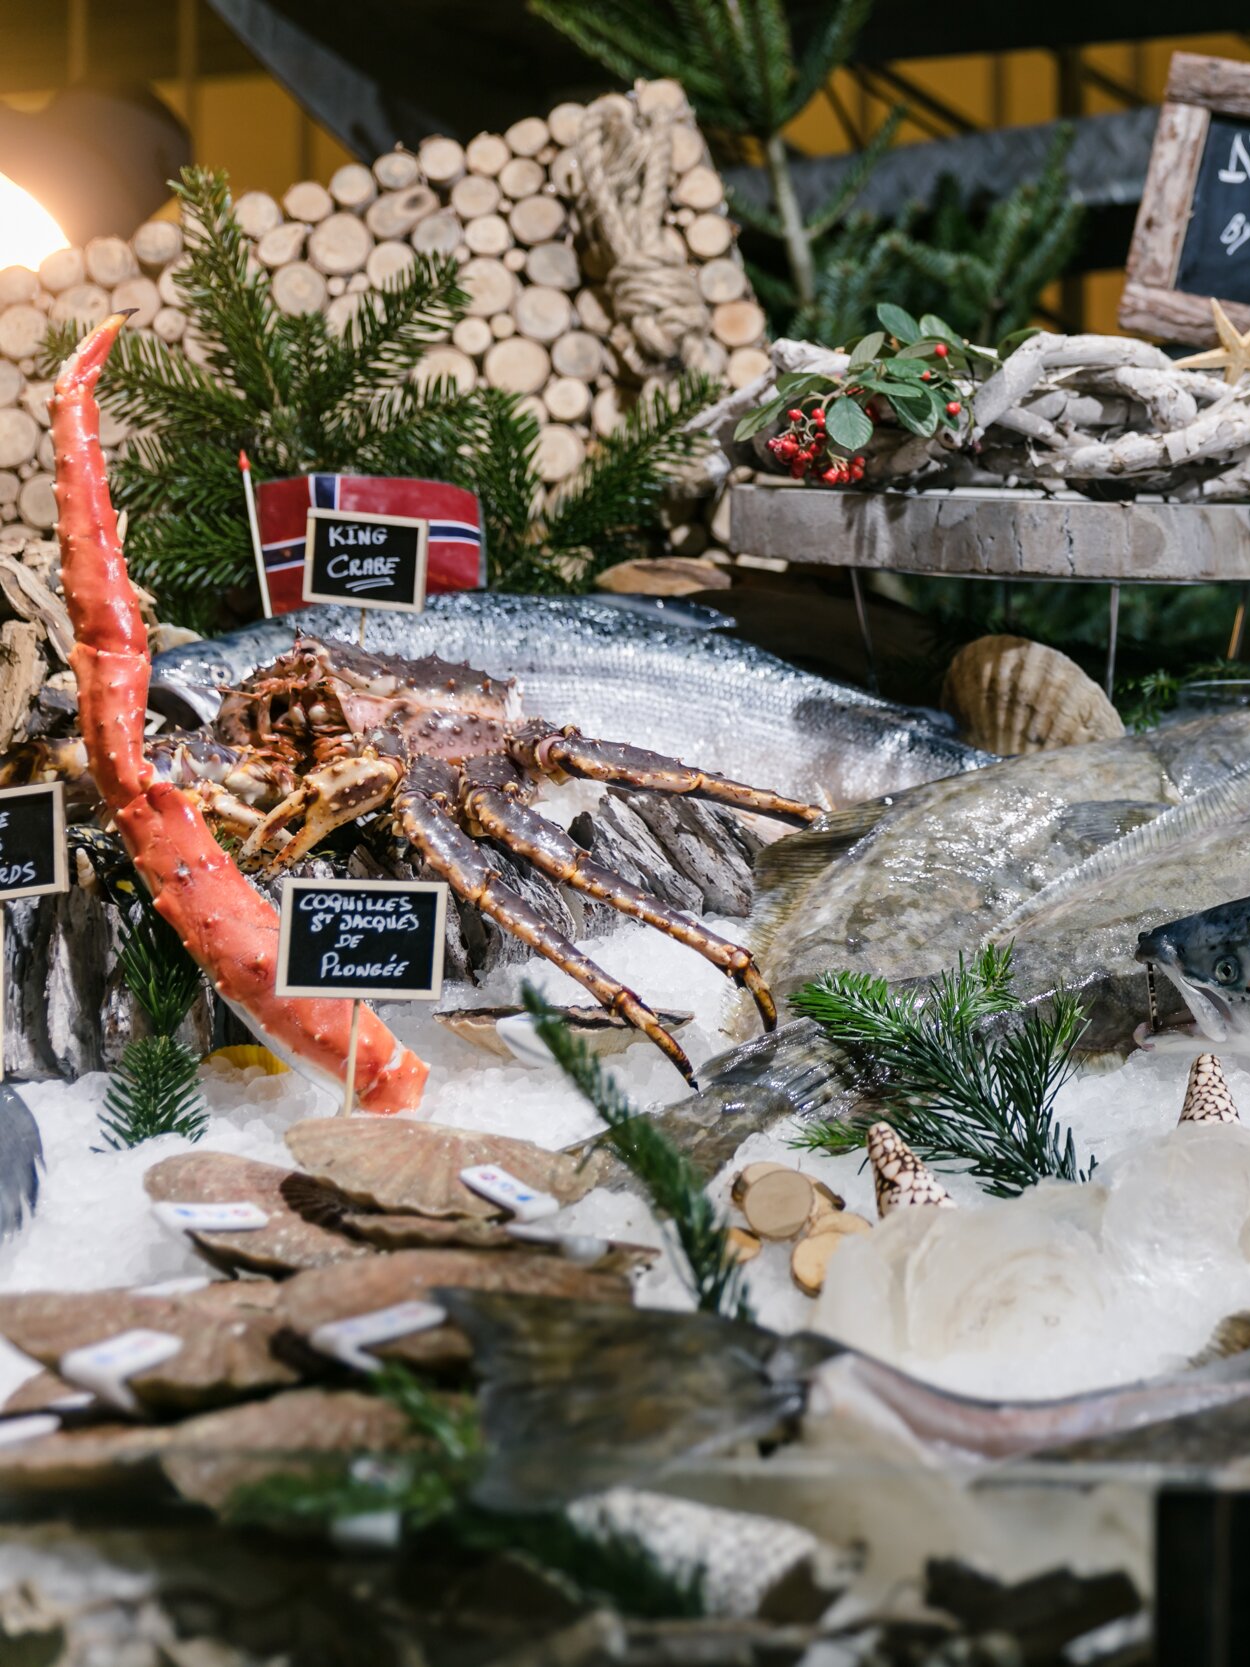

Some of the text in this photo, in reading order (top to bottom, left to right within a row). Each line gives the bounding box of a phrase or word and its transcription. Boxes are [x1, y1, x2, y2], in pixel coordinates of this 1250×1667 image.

[328, 524, 389, 548] KING
[326, 553, 401, 579] CRABE
[339, 914, 420, 933] JACQUES
[334, 934, 365, 949] DE
[320, 951, 410, 978] PLONGÉE
